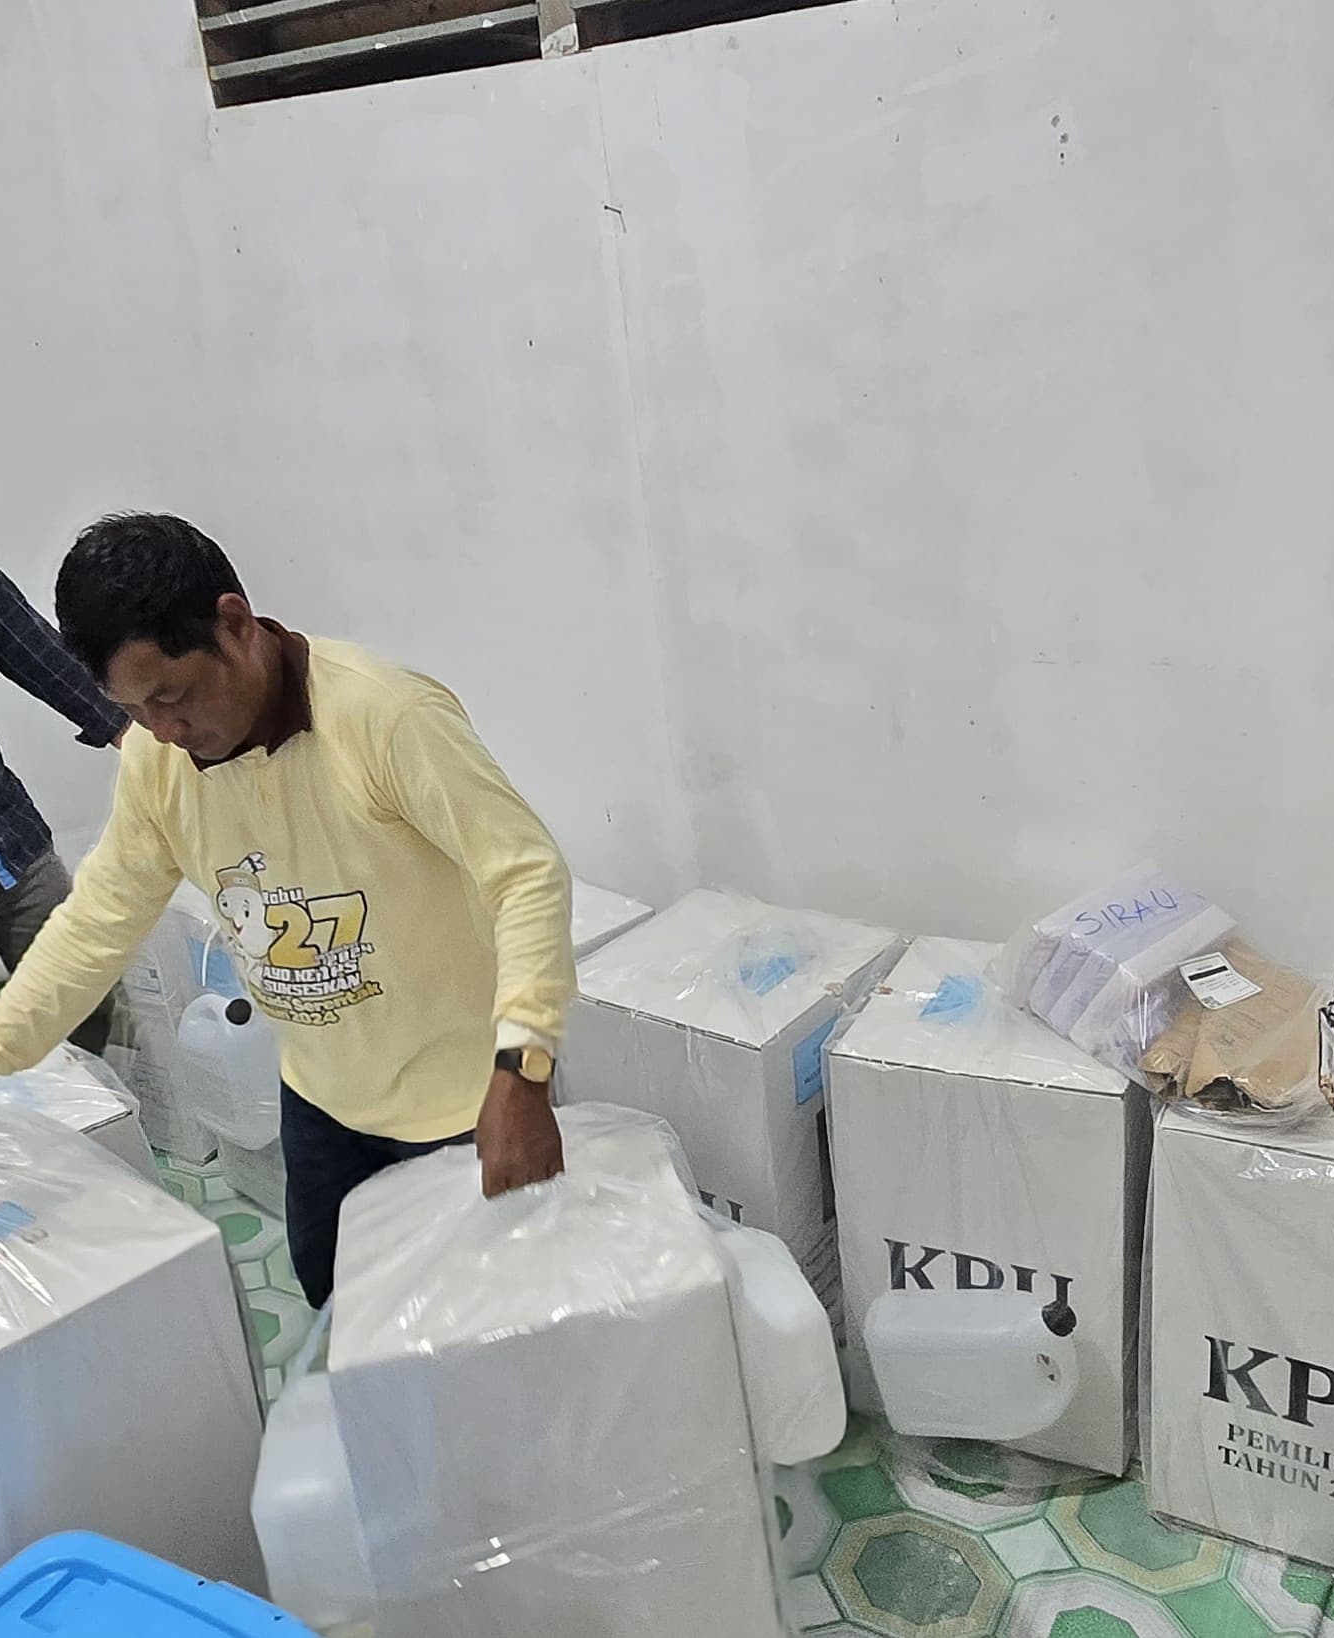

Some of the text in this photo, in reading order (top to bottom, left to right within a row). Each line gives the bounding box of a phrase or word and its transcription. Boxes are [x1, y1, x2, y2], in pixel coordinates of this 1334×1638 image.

[265, 890, 367, 969] 27
[1075, 888, 1180, 936] SIRAU
[1218, 1445, 1320, 1492] TAHUN
